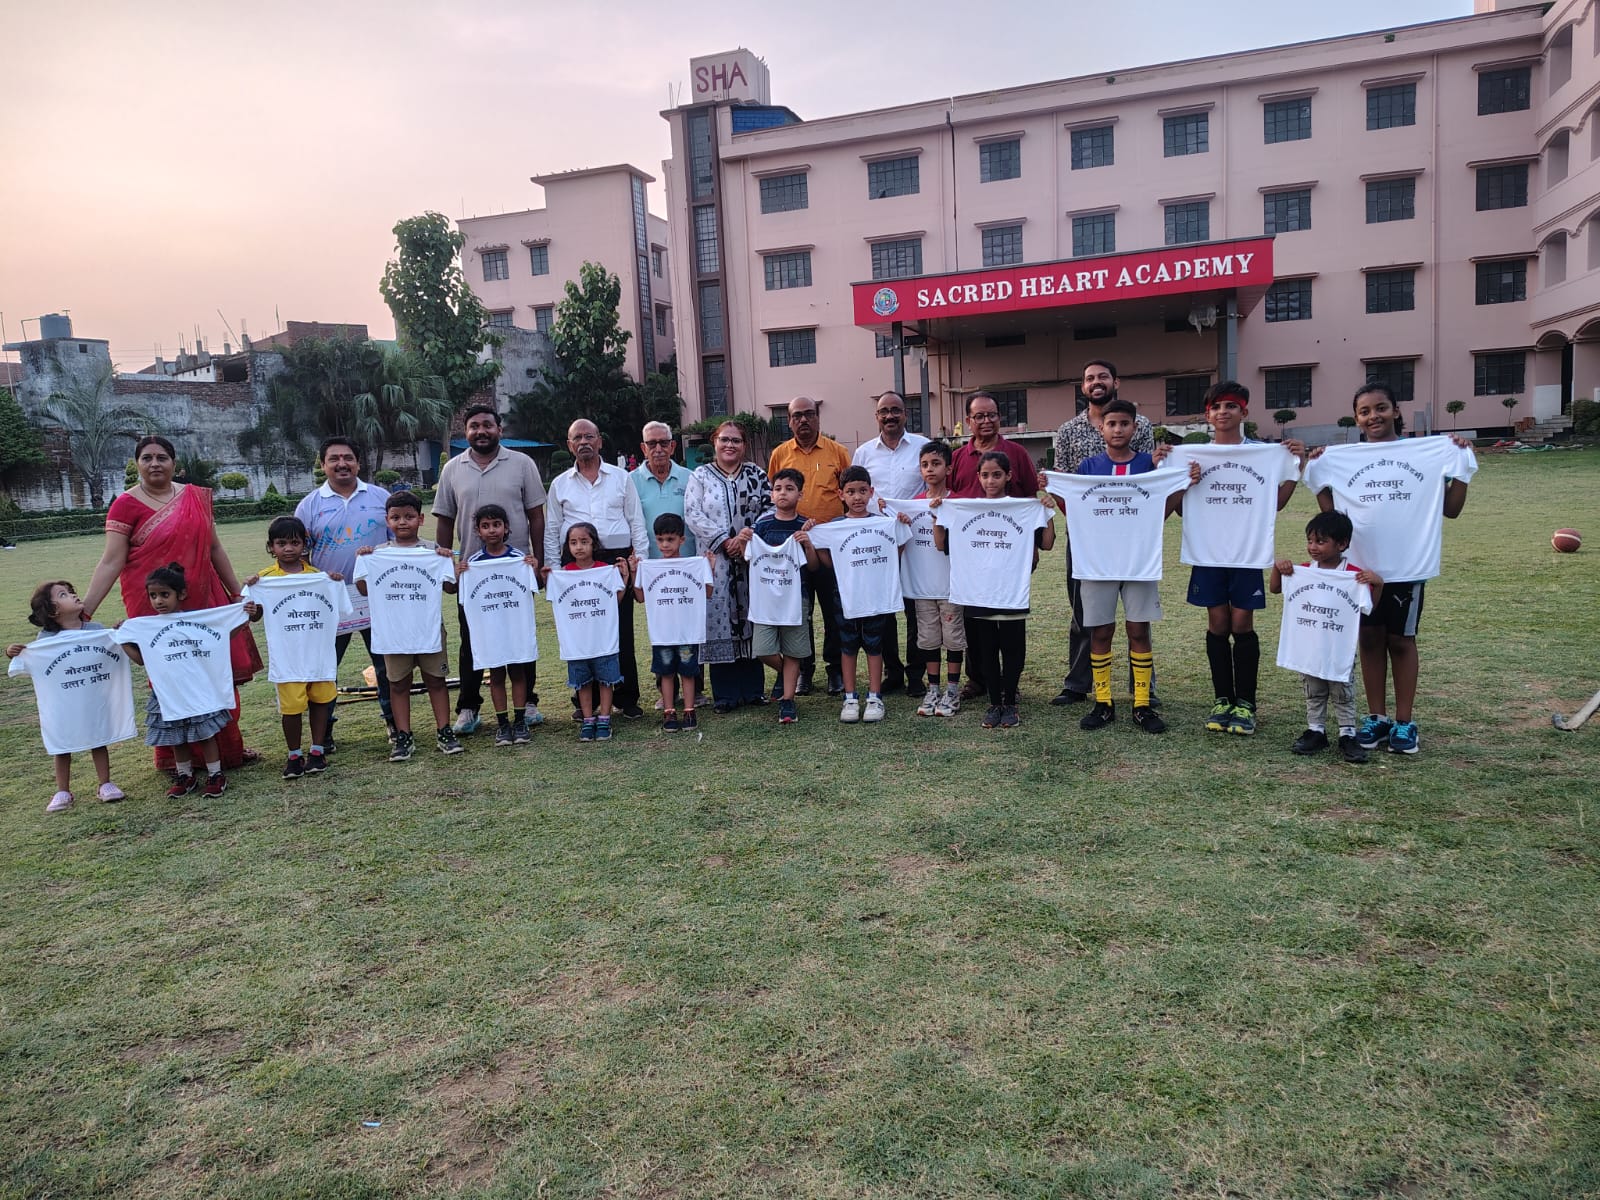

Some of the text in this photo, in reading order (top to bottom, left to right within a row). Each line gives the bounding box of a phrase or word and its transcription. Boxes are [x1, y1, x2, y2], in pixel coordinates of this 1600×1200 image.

[695, 61, 748, 93] SHA
[917, 280, 1013, 308] SACRED
[1020, 269, 1109, 298] HEART
[1115, 253, 1254, 287] ACADEMY
[1210, 481, 1248, 494] गोरखपुर
[1365, 480, 1404, 489] गोरखपुर
[1206, 495, 1253, 505] उत्तर प्रदेश
[1359, 491, 1412, 503] उत्तर प्रदेश
[976, 528, 1008, 539] गोरखपुर
[851, 545, 882, 555] गोरखपुर
[390, 581, 422, 591] गोरखपुर
[660, 586, 689, 595] गोरखपुर
[409, 591, 428, 601] प्रदेश
[483, 590, 513, 601] गोरखपुर
[570, 598, 601, 608] गोरखपुर
[287, 609, 321, 621] गोरखपुर
[1301, 601, 1340, 619] गोरखपुर
[284, 621, 325, 632] उत्तर प्रदेश
[1296, 616, 1345, 633] उत्तर प्रदेश
[167, 639, 204, 649] गोरखपुर
[163, 648, 212, 662] उत्तर प्रदेश
[63, 662, 104, 676] गोरखपुर
[60, 672, 112, 690] उत्तर प्रदेश
